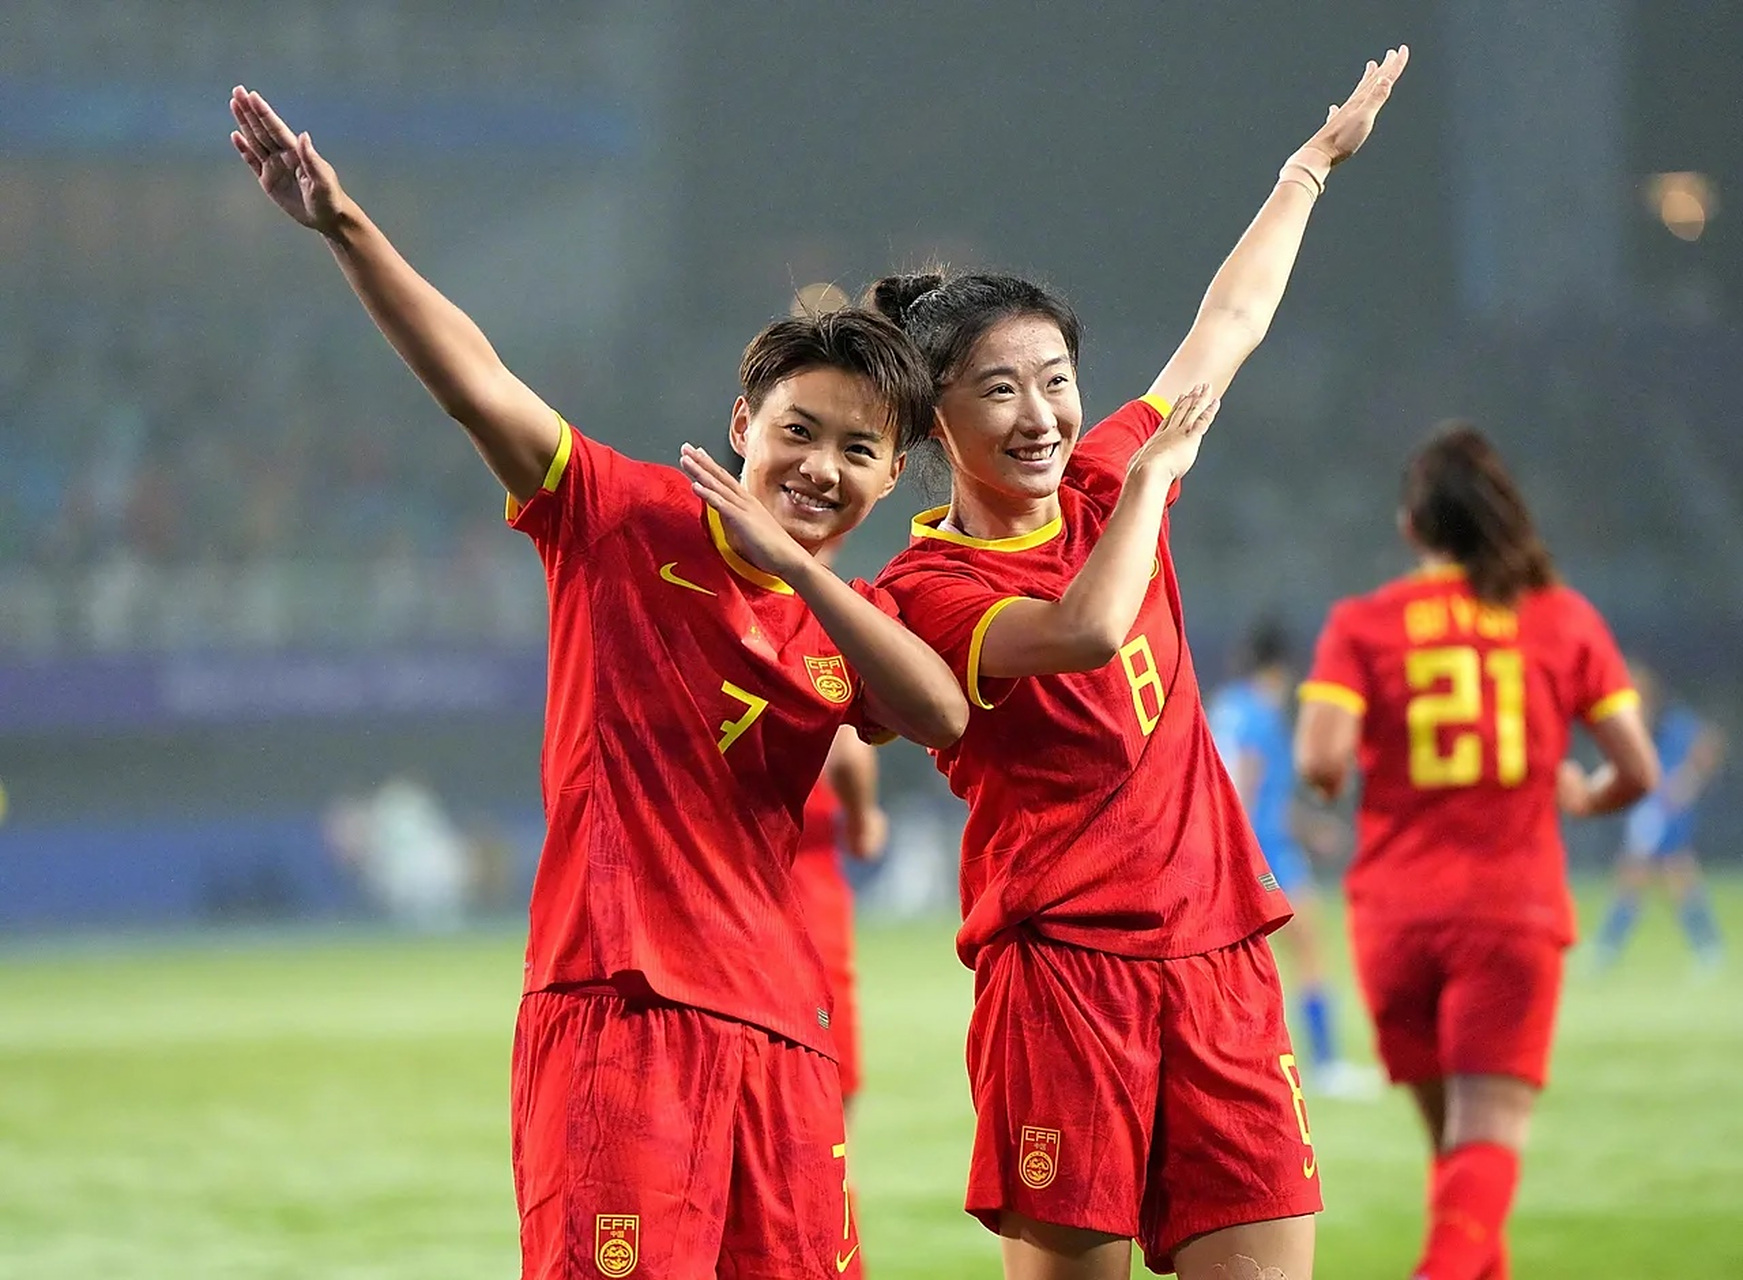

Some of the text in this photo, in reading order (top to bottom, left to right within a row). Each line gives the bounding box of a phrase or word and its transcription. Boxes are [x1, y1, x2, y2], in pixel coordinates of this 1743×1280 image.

[808, 659, 840, 669] CFA
[1118, 633, 1166, 737] 8
[717, 680, 769, 755] 7
[1407, 646, 1527, 788] 21
[1025, 1130, 1057, 1144] CFA
[600, 1218, 635, 1230] CFA
